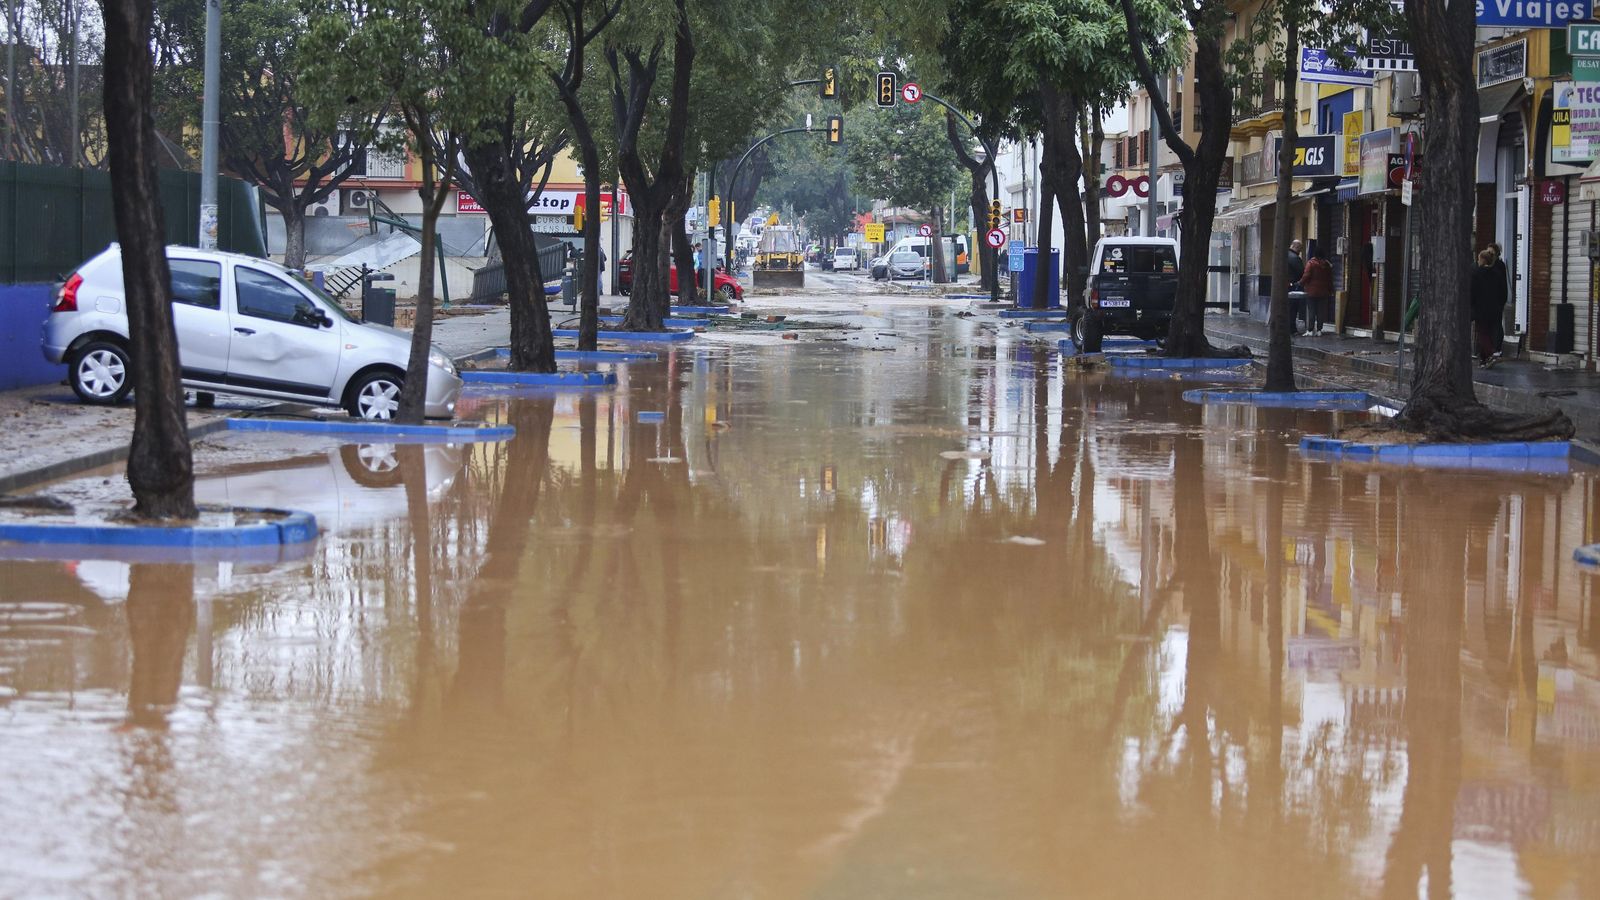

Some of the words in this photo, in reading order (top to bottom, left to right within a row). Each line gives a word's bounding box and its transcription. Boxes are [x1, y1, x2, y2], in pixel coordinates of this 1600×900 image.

[1495, 0, 1585, 25] Viajes
[1305, 146, 1325, 166] GLS
[536, 216, 567, 224] CURSO
